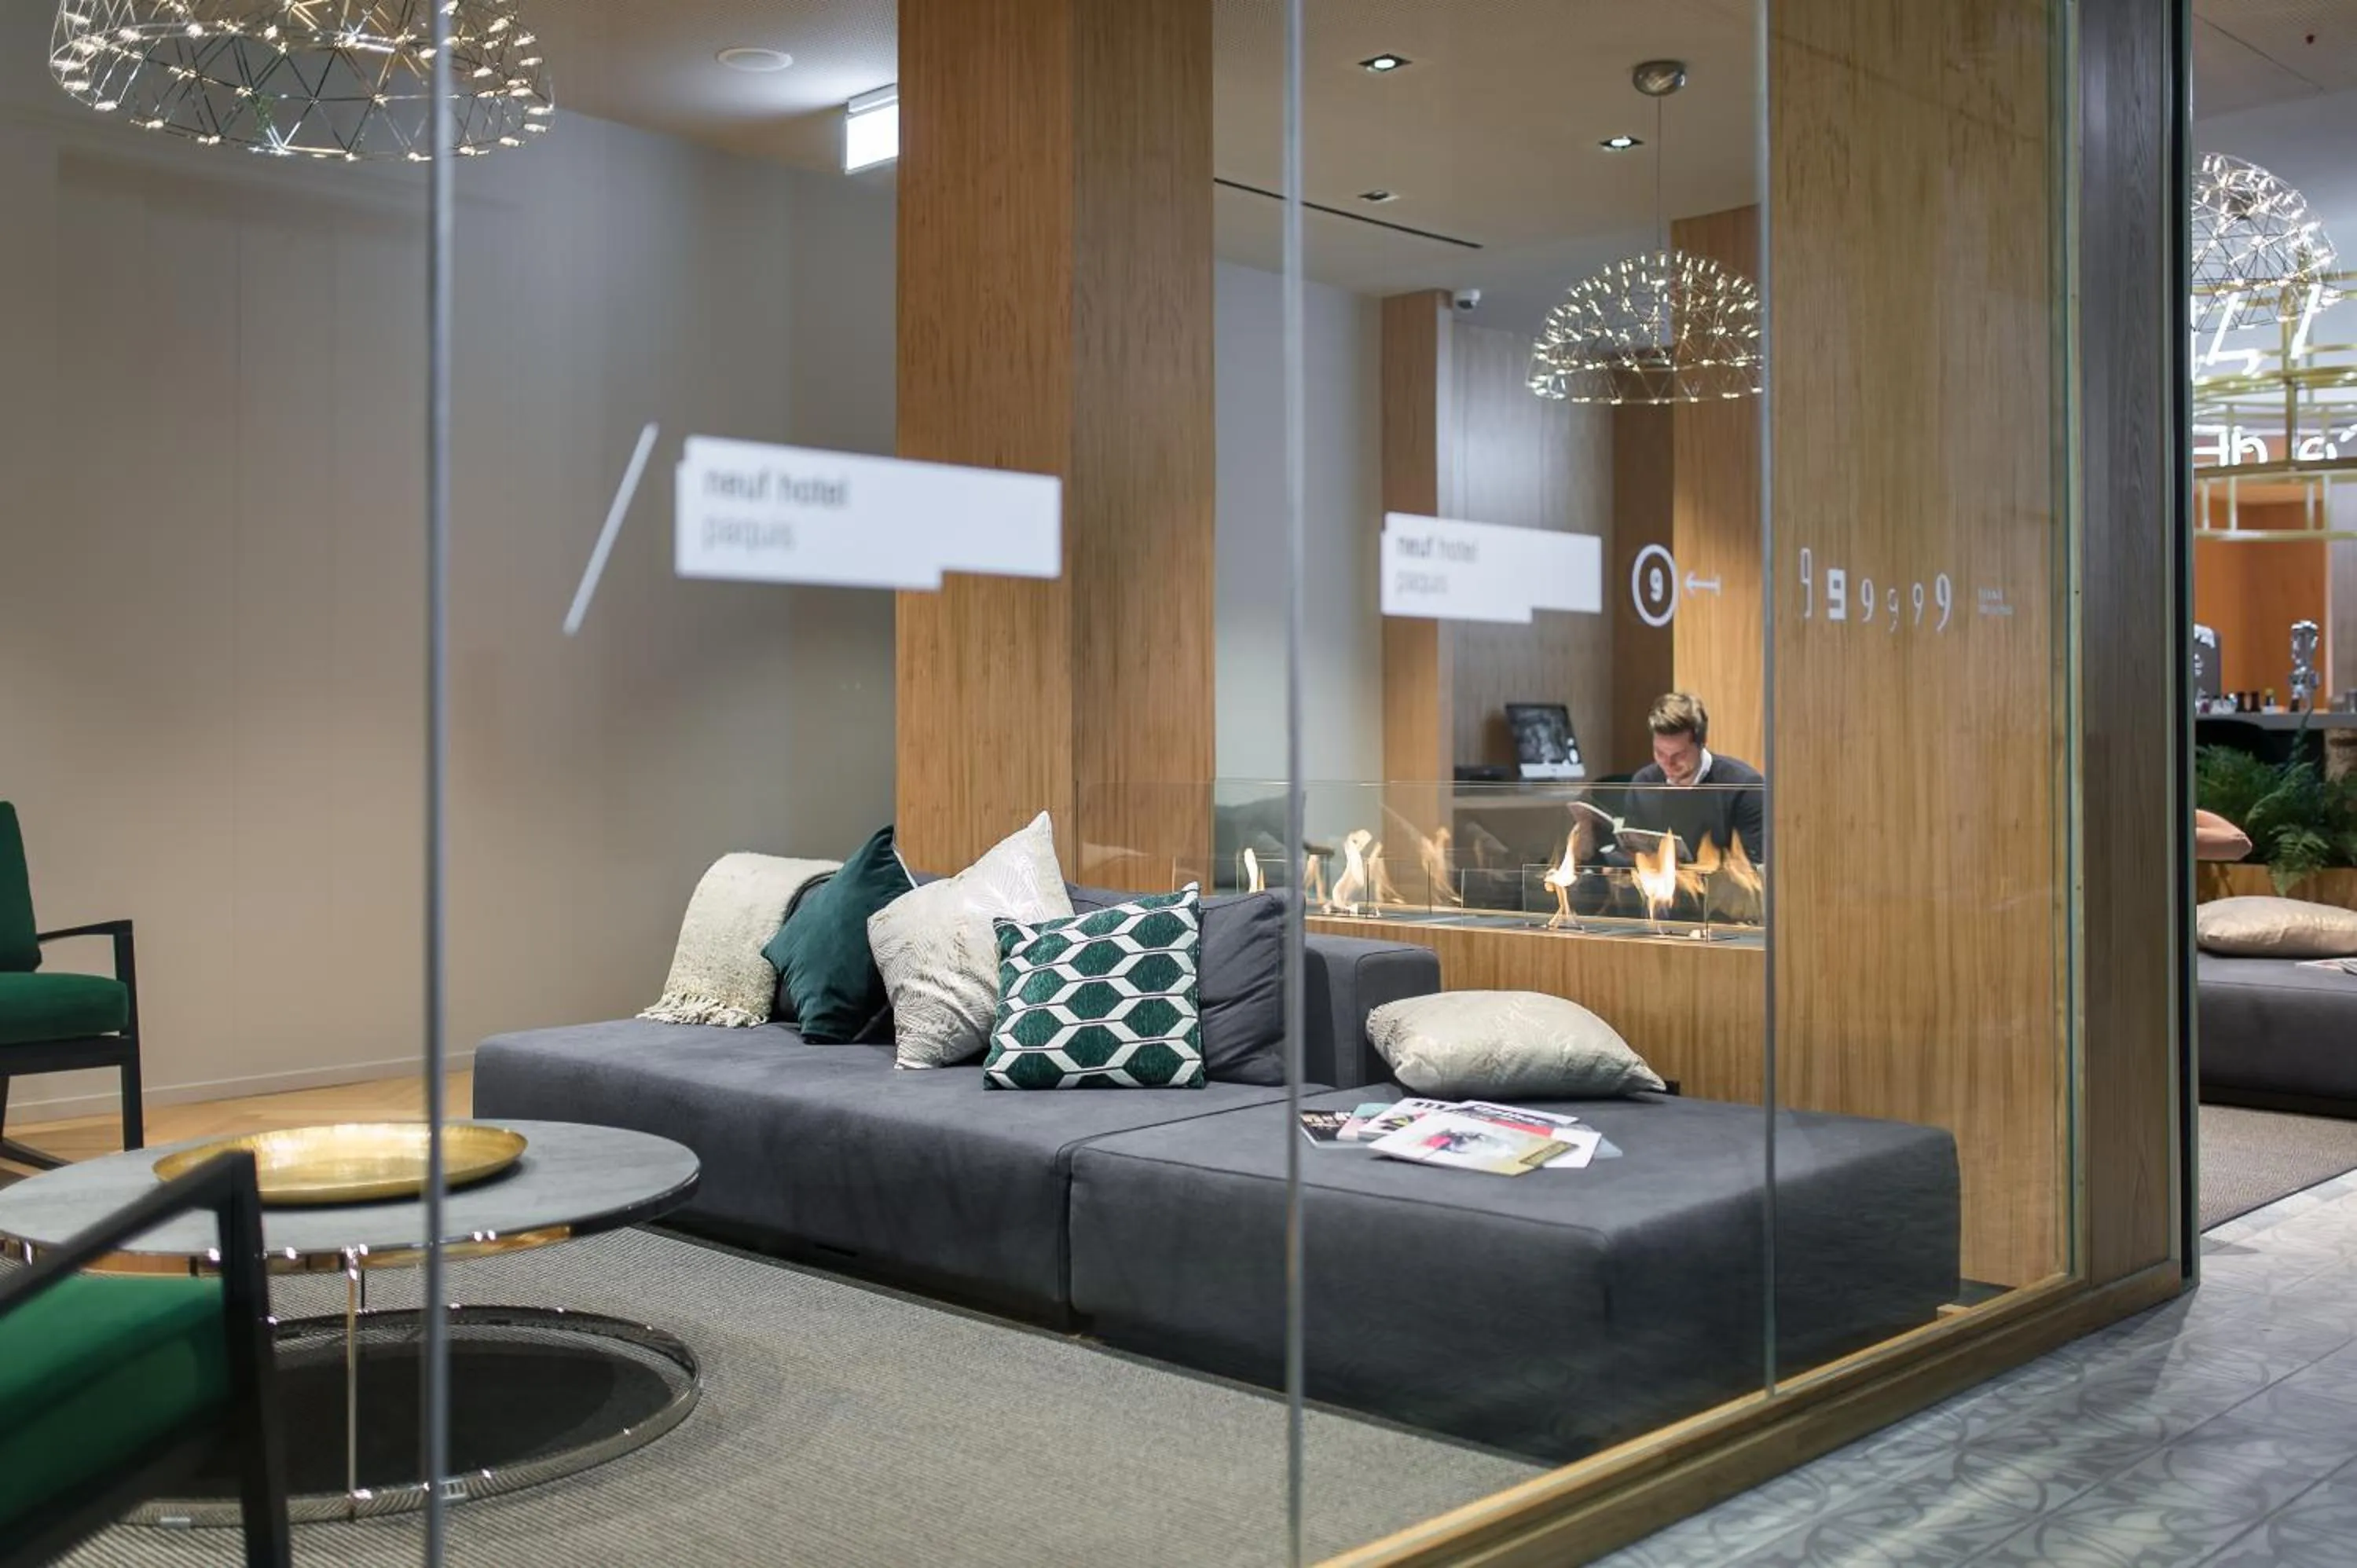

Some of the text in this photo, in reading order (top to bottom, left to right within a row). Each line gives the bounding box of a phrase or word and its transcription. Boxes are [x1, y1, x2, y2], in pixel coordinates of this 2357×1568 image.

[1650, 567, 1663, 603] 9
[1861, 578, 1875, 623] 9
[1935, 573, 1952, 632] 9
